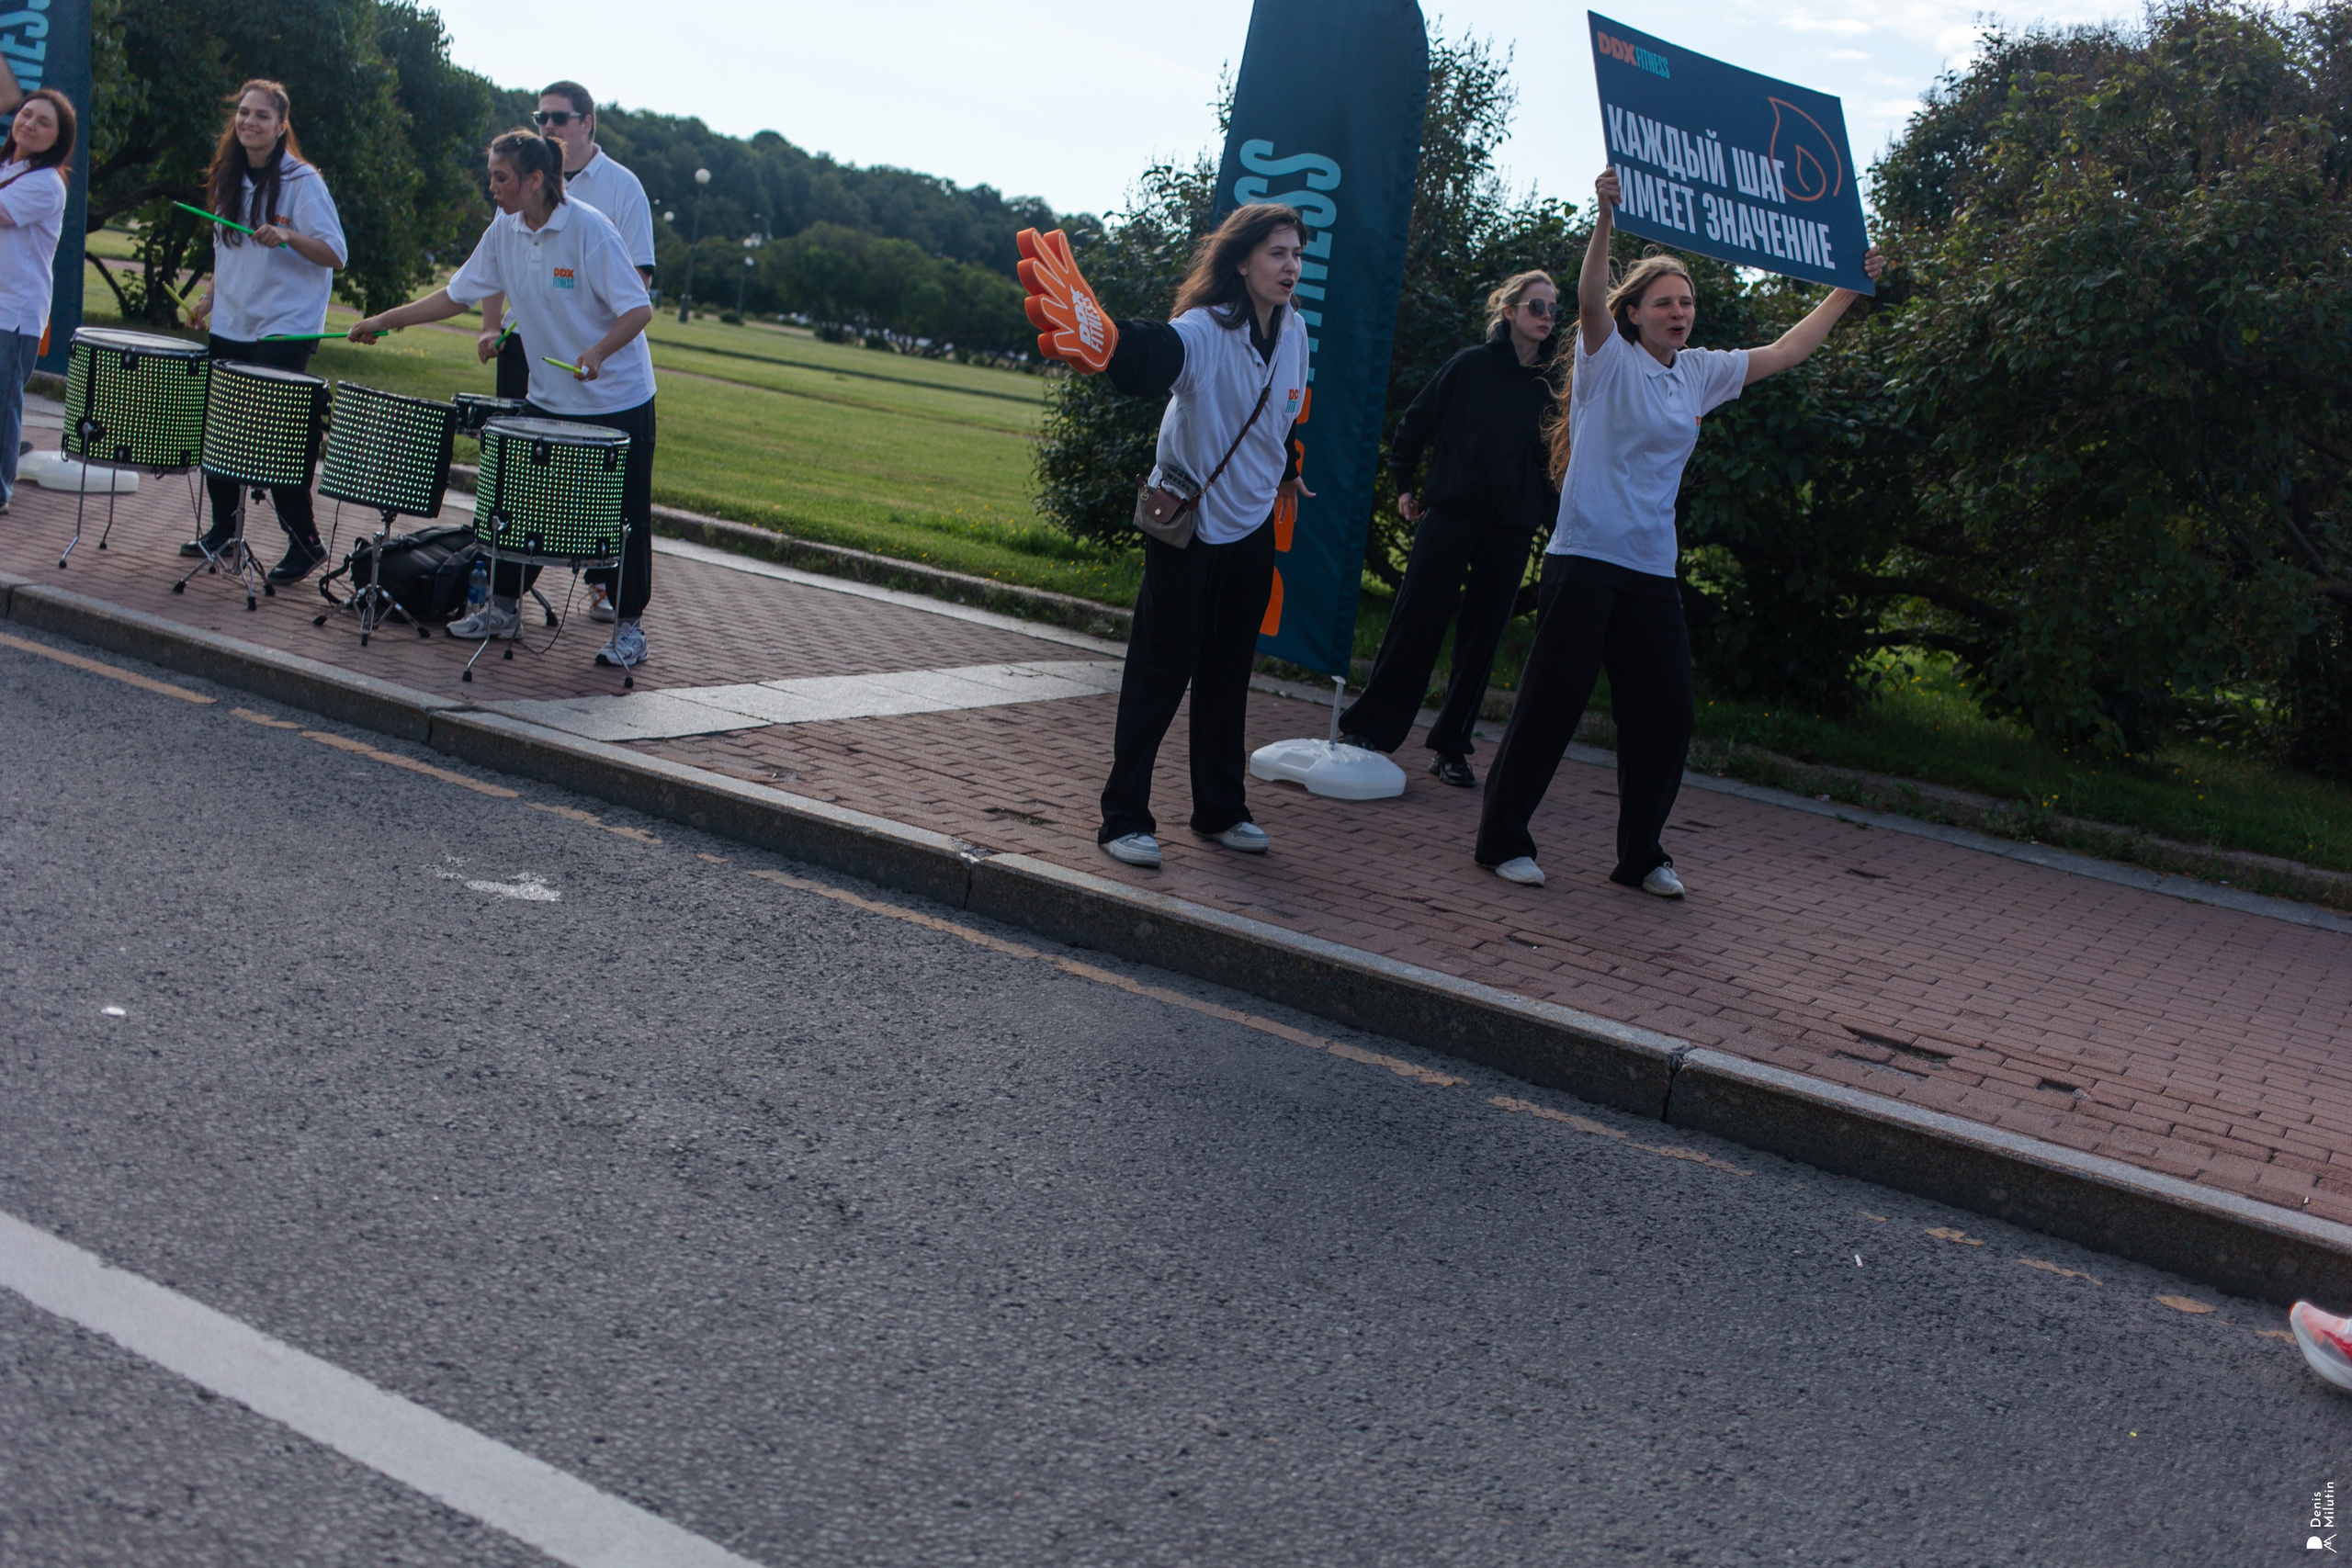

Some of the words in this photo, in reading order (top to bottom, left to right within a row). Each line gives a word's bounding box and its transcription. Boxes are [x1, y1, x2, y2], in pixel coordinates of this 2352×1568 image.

[1607, 103, 1727, 187] КАЖДЫЙ
[1731, 146, 1786, 204] ШАГ
[1614, 163, 1696, 234] ИМЕЕТ
[1702, 192, 1836, 269] ЗНАЧЕНИЕ
[554, 267, 574, 278] DDX
